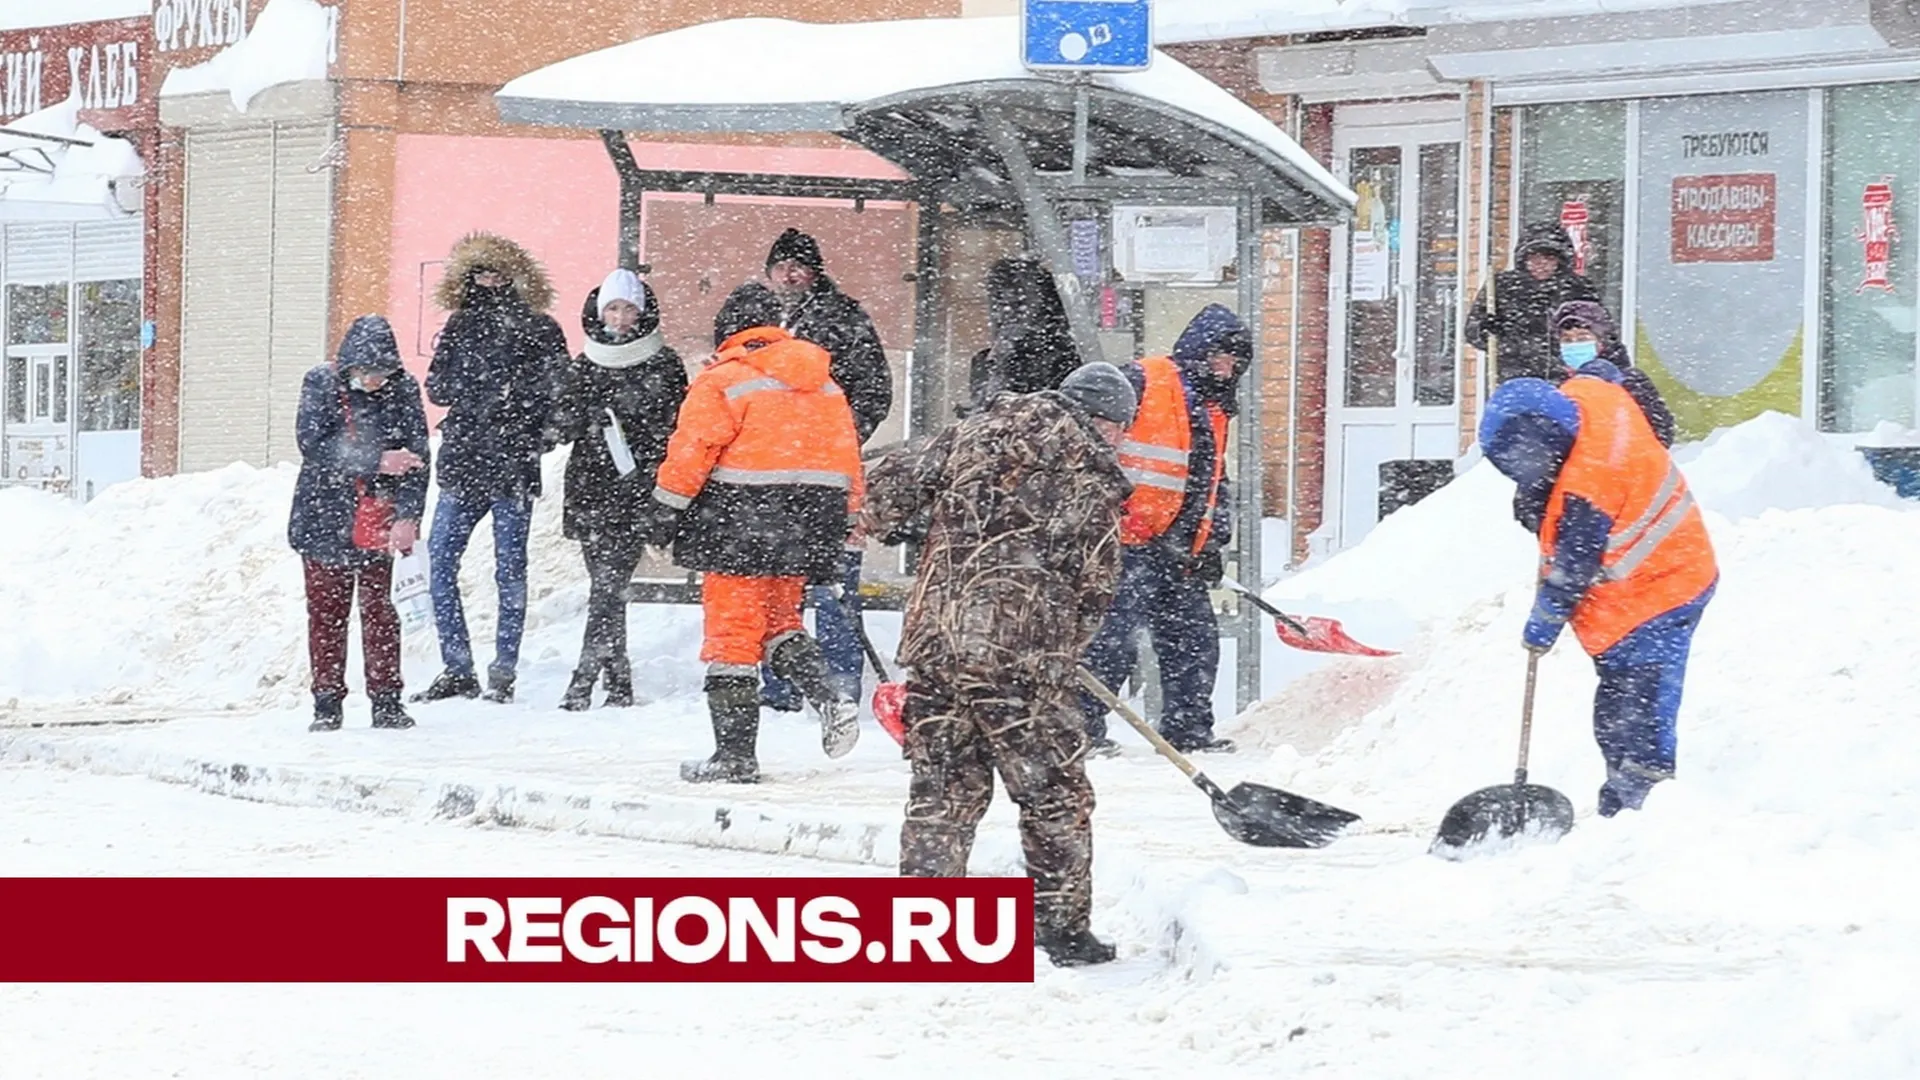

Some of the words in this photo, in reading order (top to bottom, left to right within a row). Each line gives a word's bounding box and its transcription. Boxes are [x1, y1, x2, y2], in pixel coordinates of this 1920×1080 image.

[155, 0, 247, 51] ФРУКТЫ
[0, 35, 42, 116] ИЙ
[67, 41, 138, 110] ХЛЕБ
[1682, 131, 1769, 158] ТРЕБУЮТСЯ
[1679, 184, 1765, 213] ПРОДАВЦЫ
[1686, 222, 1761, 249] КАССИРЫ
